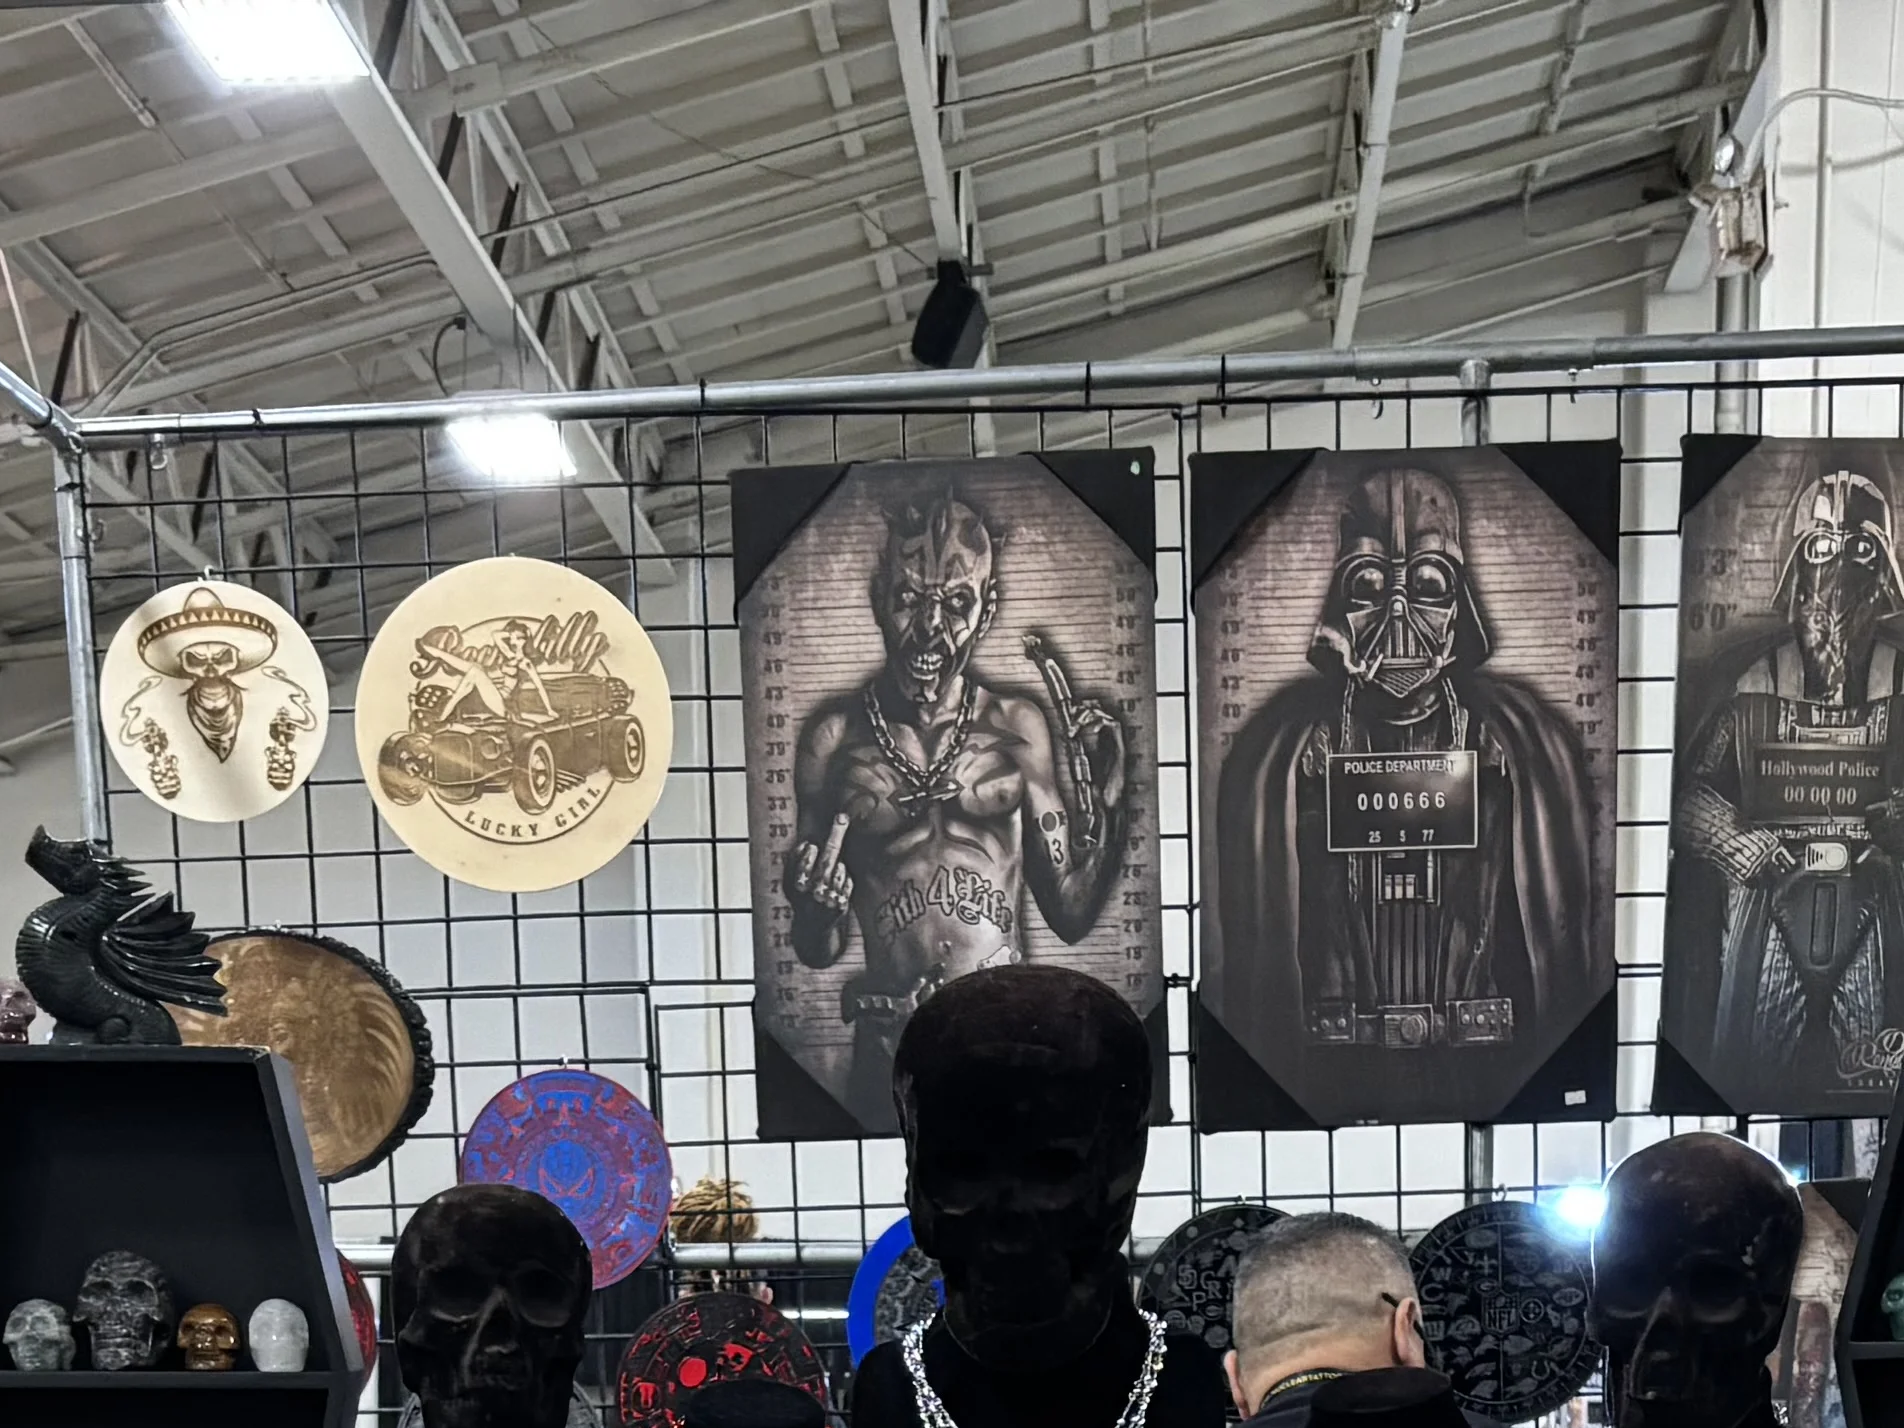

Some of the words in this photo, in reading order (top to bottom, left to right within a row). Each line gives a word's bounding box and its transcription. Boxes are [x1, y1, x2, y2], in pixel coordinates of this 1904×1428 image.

[409, 610, 611, 679] Rockbilly
[1344, 761, 1384, 775] POLICE
[1385, 759, 1457, 773] DEPARTMENT
[1761, 759, 1834, 780] Hollywood
[1839, 761, 1880, 778] Police
[1784, 785, 1805, 803] 00
[1810, 786, 1831, 805] 00
[1836, 786, 1857, 805] 00
[463, 810, 539, 838] LUCKY
[555, 788, 602, 828] GIRL
[1368, 830, 1381, 843] 25
[1399, 830, 1406, 842] 5
[1422, 829, 1434, 842] 77
[927, 864, 955, 917] 4
[953, 866, 1013, 934] Life
[1487, 1309, 1517, 1329] NFL
